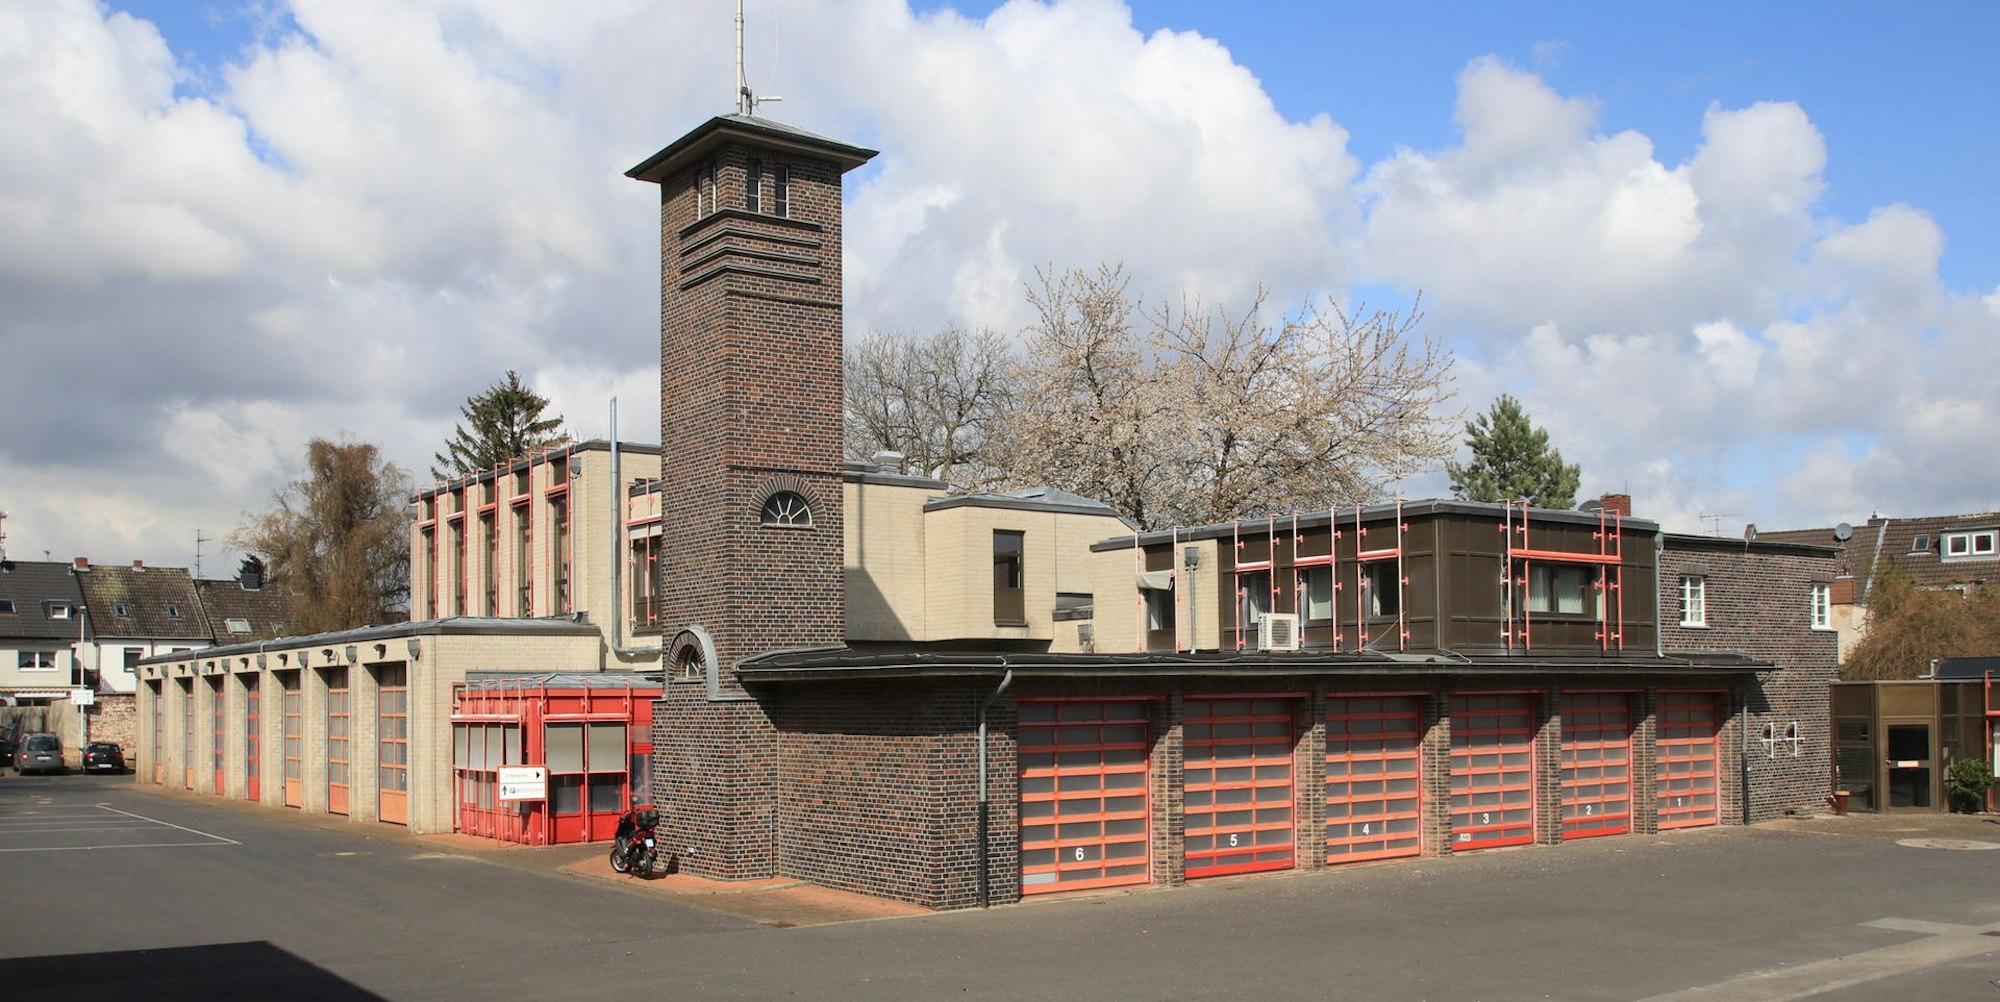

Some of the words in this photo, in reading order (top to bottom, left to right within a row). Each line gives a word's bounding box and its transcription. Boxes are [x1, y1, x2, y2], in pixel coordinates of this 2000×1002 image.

[1677, 797, 1682, 807] 1
[1586, 805, 1592, 815] 2
[1482, 812, 1490, 824] 3
[1362, 823, 1370, 835] 4
[1229, 833, 1238, 847] 5
[1075, 847, 1085, 861] 6
